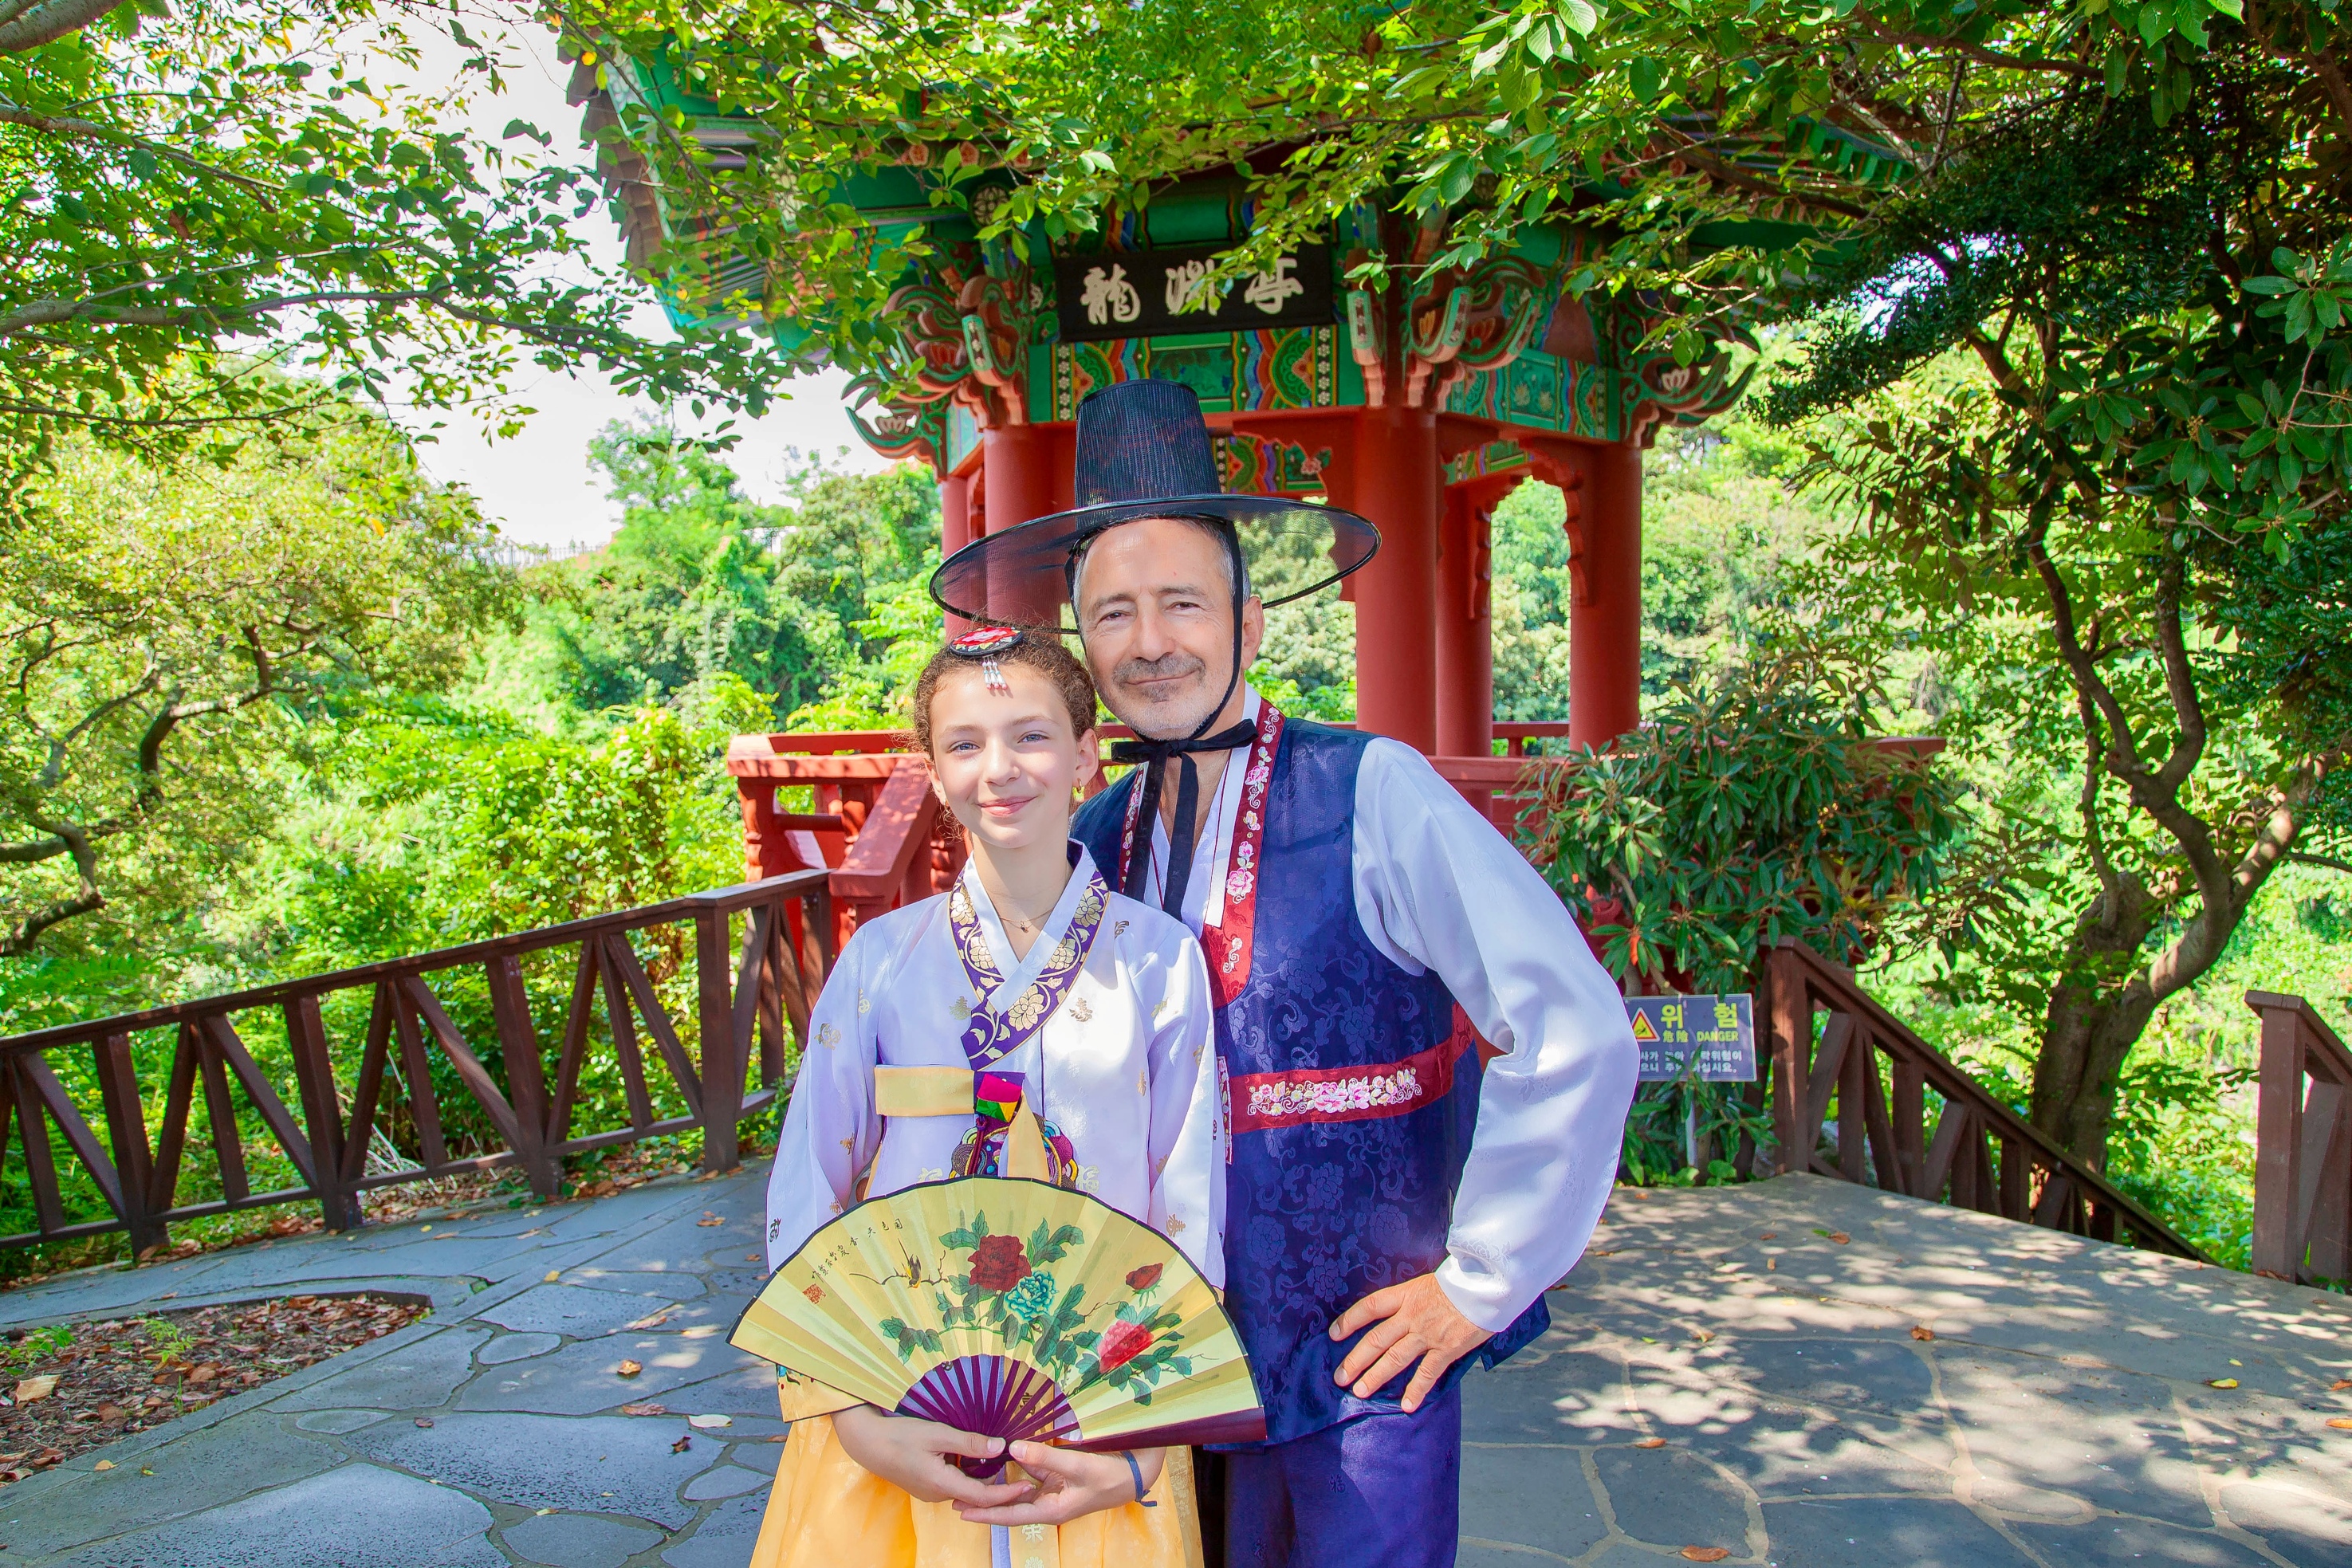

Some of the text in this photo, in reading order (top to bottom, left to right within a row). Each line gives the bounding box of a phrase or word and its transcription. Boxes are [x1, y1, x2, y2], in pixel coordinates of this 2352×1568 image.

[1697, 1031, 1739, 1042] DANGER
[1640, 1051, 1659, 1062] 사가
[1640, 1062, 1659, 1073] 으니
